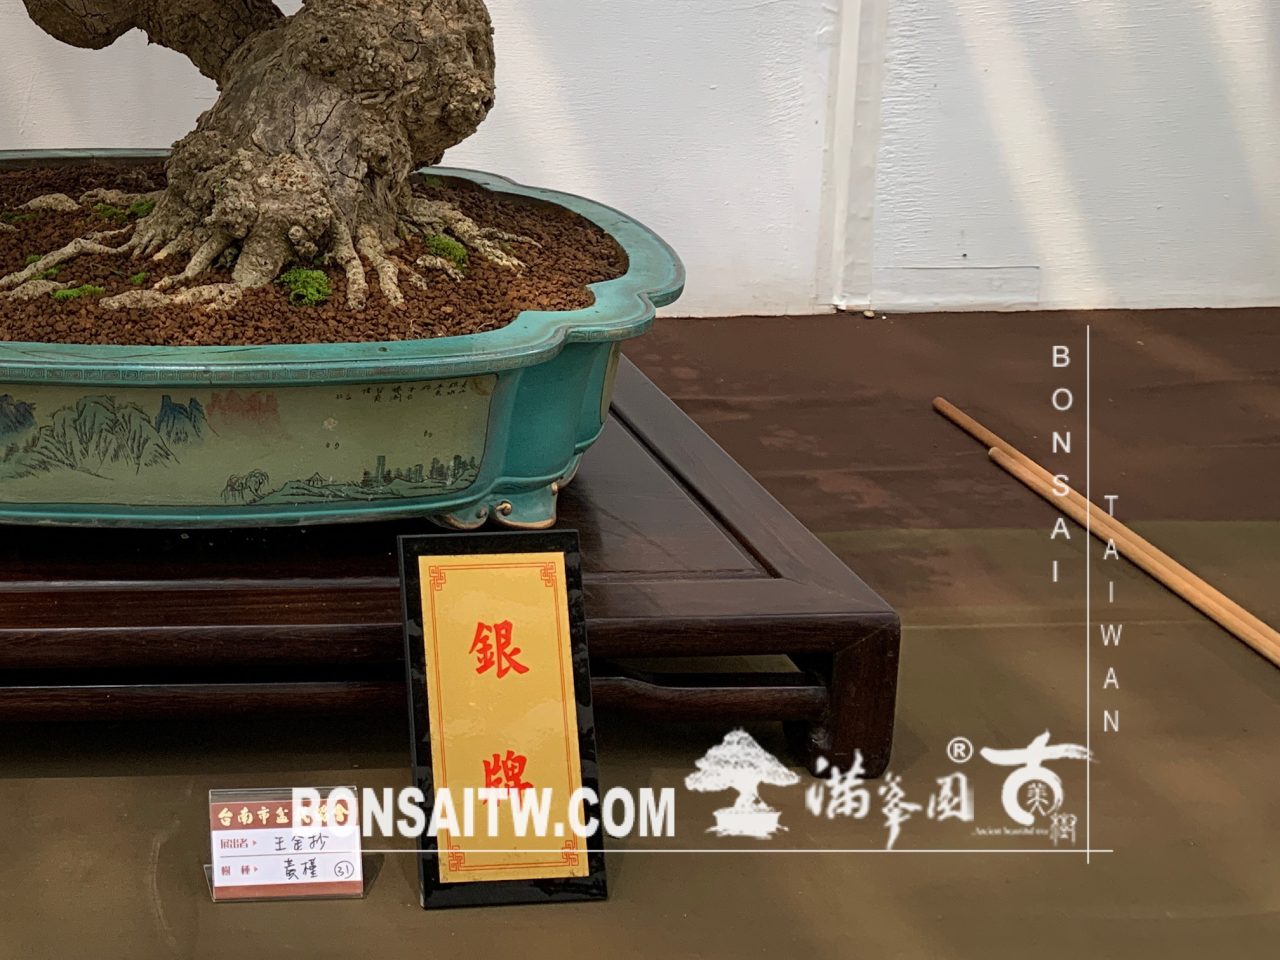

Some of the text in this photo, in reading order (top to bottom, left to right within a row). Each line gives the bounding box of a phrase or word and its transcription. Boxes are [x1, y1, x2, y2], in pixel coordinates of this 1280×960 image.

[468, 619, 534, 810] 銀牌
[218, 803, 350, 827] 台南市盆會
